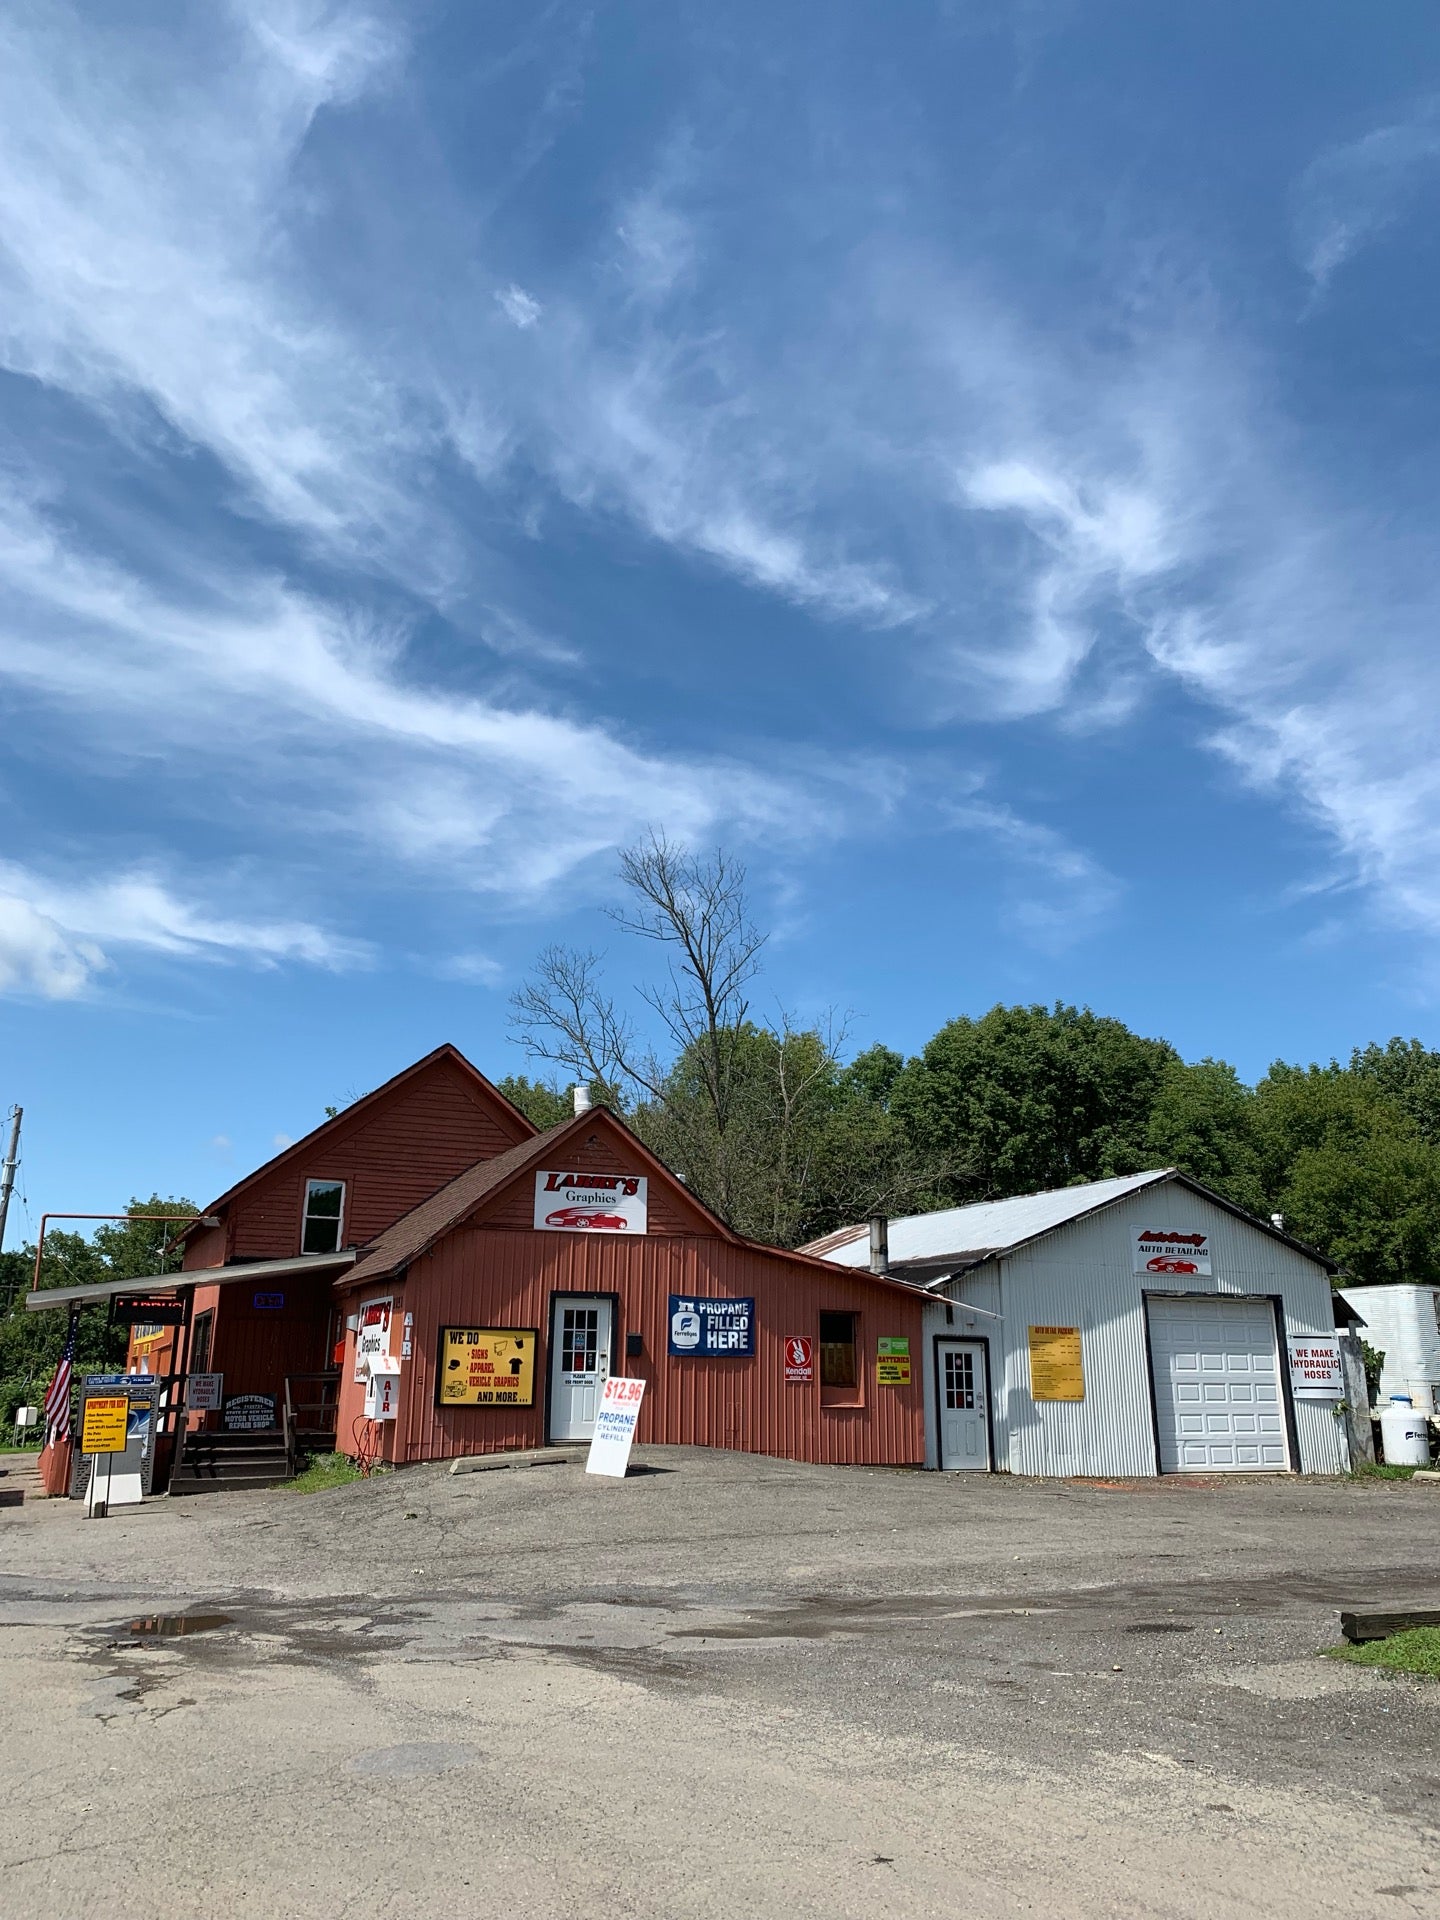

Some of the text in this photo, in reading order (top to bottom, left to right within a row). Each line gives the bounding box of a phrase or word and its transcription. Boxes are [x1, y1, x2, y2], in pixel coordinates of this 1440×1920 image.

[565, 1190, 616, 1204] Graphics
[1138, 1245, 1208, 1256] AUTO DETAILING
[699, 1302, 749, 1315] PROPANE
[707, 1315, 749, 1331] FILLED
[361, 1333, 381, 1354] Graphics
[449, 1331, 480, 1345] WE DO
[706, 1331, 749, 1349] HERE
[471, 1348, 489, 1360] SIGNS
[1296, 1349, 1334, 1358] WE MAKE
[469, 1362, 495, 1374] APPAREL
[1293, 1360, 1339, 1368] HYDRAULIC
[786, 1367, 812, 1375] Kendall
[1304, 1370, 1332, 1379] HOSES
[469, 1376, 519, 1388] VEHICLE GRAPHICS
[382, 1380, 391, 1412] AIR
[477, 1391, 494, 1402] AND
[605, 1380, 642, 1401] $12.96
[226, 1395, 274, 1410] REGISTERED
[599, 1412, 636, 1426] PROPANE
[597, 1423, 632, 1433] CYLINDER
[600, 1433, 625, 1442] REFILL
